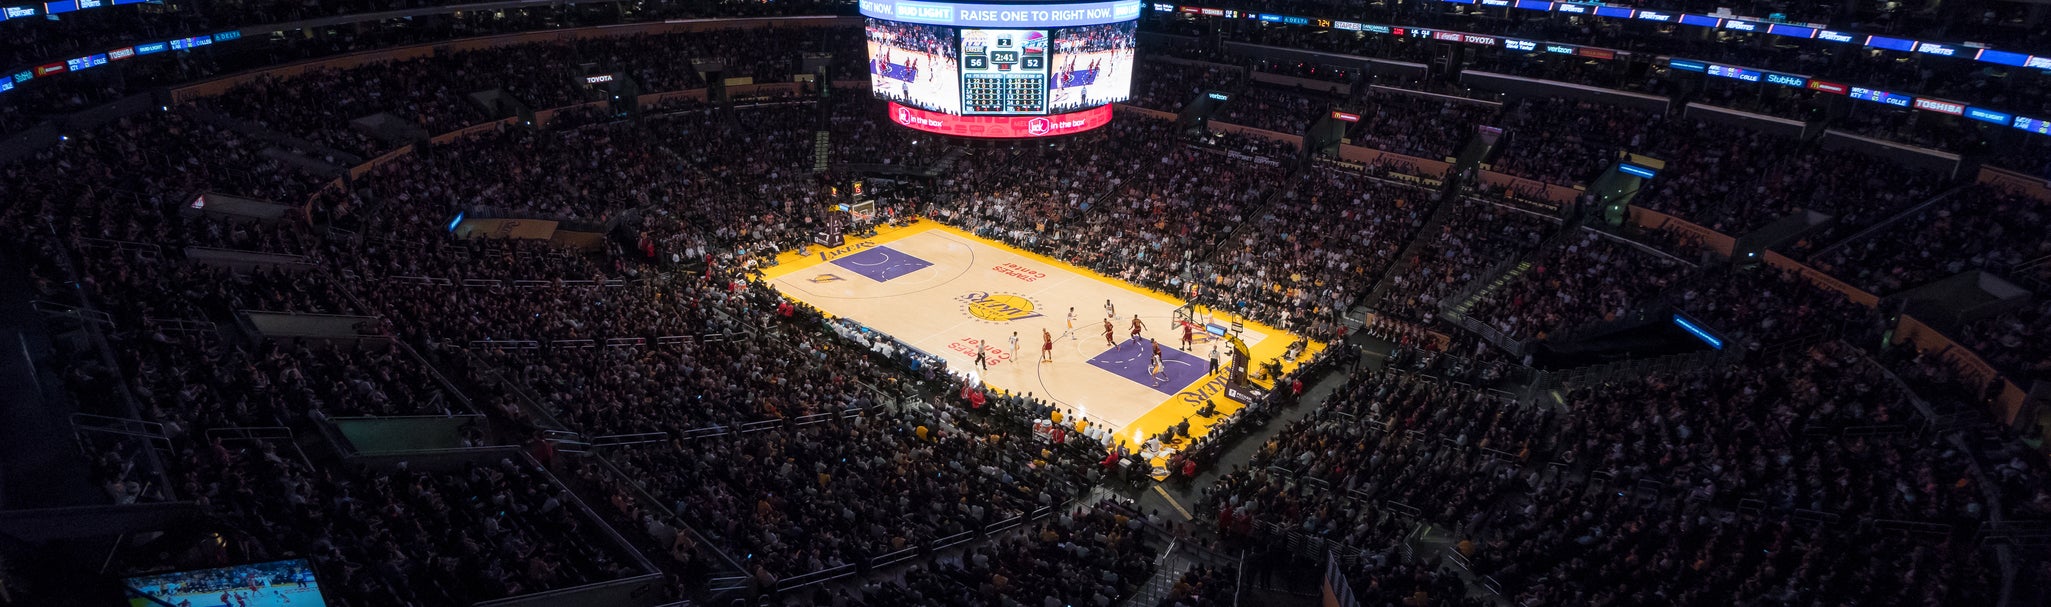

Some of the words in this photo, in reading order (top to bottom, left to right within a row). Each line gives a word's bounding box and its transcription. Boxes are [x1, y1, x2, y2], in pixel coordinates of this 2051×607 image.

[874, 4, 893, 15] NOW.
[898, 5, 917, 17] BUD
[918, 7, 951, 19] LIGHT
[961, 10, 998, 21] RAISE
[1000, 11, 1029, 21] ONE
[1031, 11, 1049, 21] TO
[1051, 9, 1085, 20] RIGHT
[1087, 8, 1112, 19] NOW.
[1290, 16, 1308, 24] DELTA
[221, 31, 240, 40] DELTA
[1465, 35, 1495, 45] TOYOTA
[109, 48, 135, 59] TOSHIBA
[1547, 46, 1572, 54] verizon
[995, 53, 1014, 61] 2:41
[970, 59, 982, 67] 56
[1027, 59, 1039, 67] 52
[587, 75, 613, 84] TOYOTA
[1767, 74, 1802, 87] StubHub
[1851, 86, 1868, 94] WICH
[1209, 93, 1228, 101] verizon
[1886, 98, 1907, 106] COLLE
[1916, 99, 1963, 114] TOSHIBA
[917, 116, 927, 125] the
[929, 119, 942, 127] box
[1051, 122, 1058, 130] in
[1060, 120, 1071, 129] the
[1073, 118, 1084, 126] box
[820, 241, 875, 261] LAKERS
[992, 265, 1037, 283] STAPLES
[1003, 262, 1046, 279] Center
